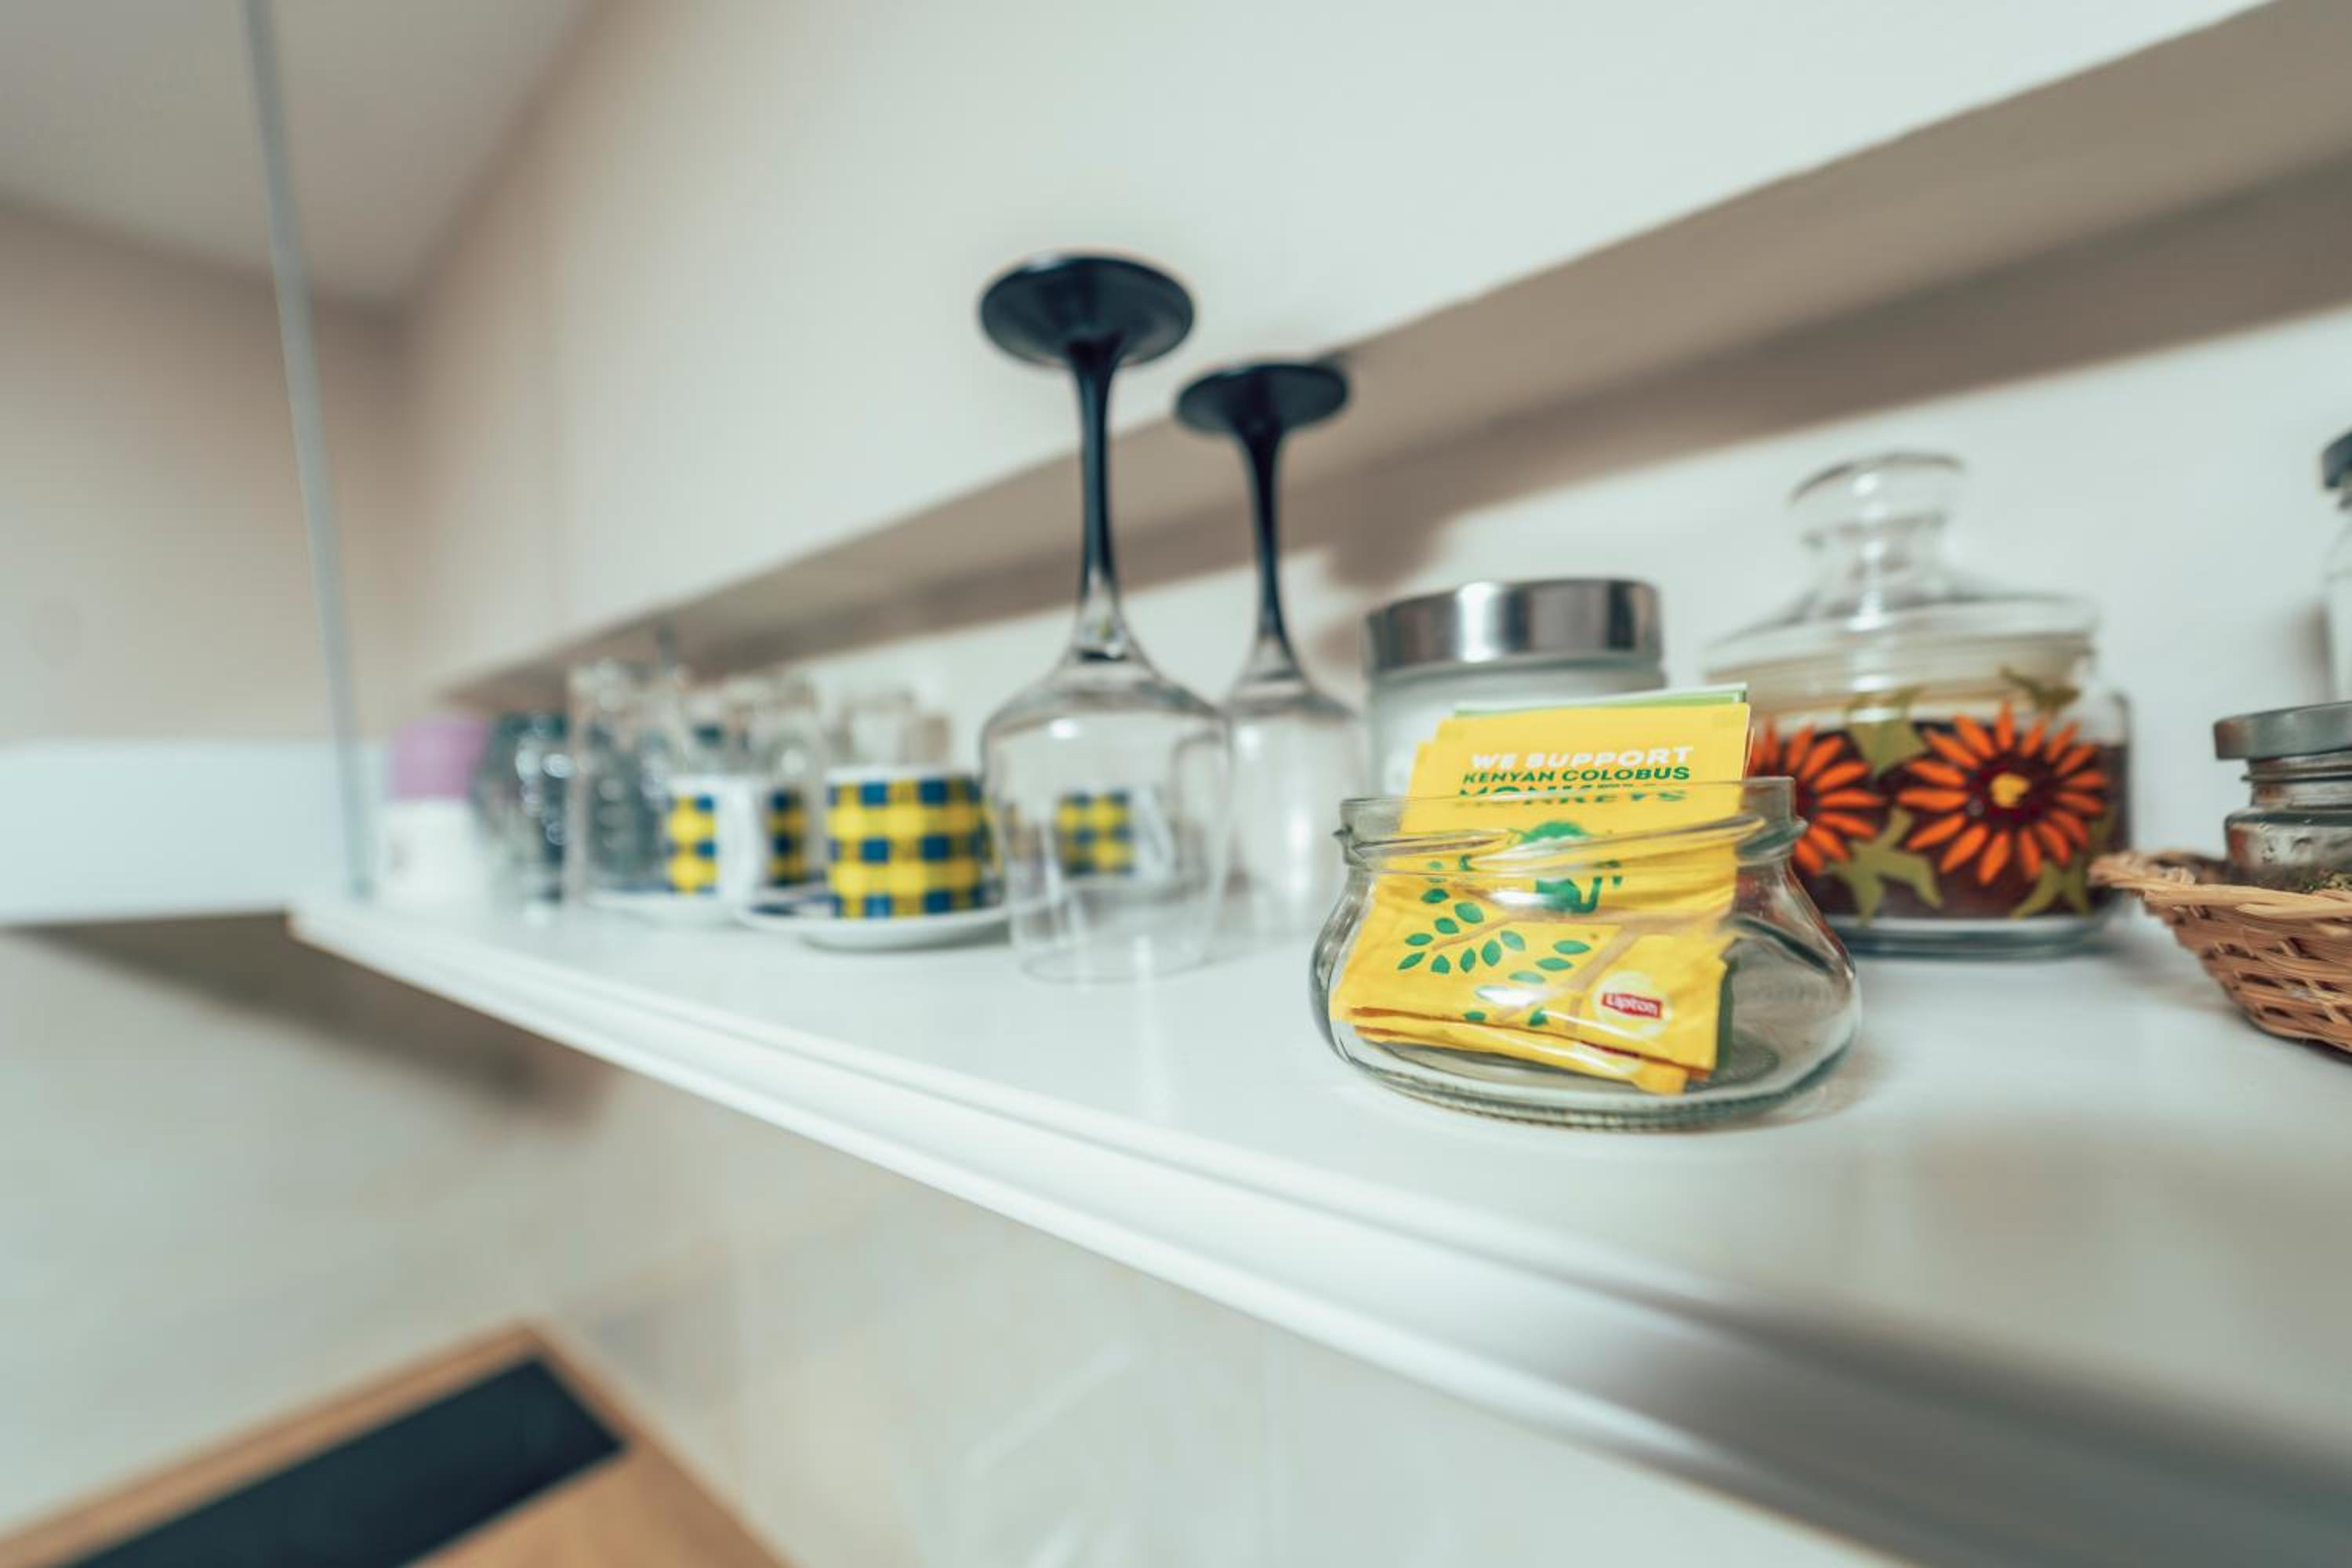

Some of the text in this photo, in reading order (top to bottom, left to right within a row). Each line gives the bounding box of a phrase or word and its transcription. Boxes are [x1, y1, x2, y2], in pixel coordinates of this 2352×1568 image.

[1471, 746, 1693, 769] WE SUPPORT
[1463, 767, 1690, 783] KENYAN COLOBUS
[1605, 993, 1658, 1016] Lipton
